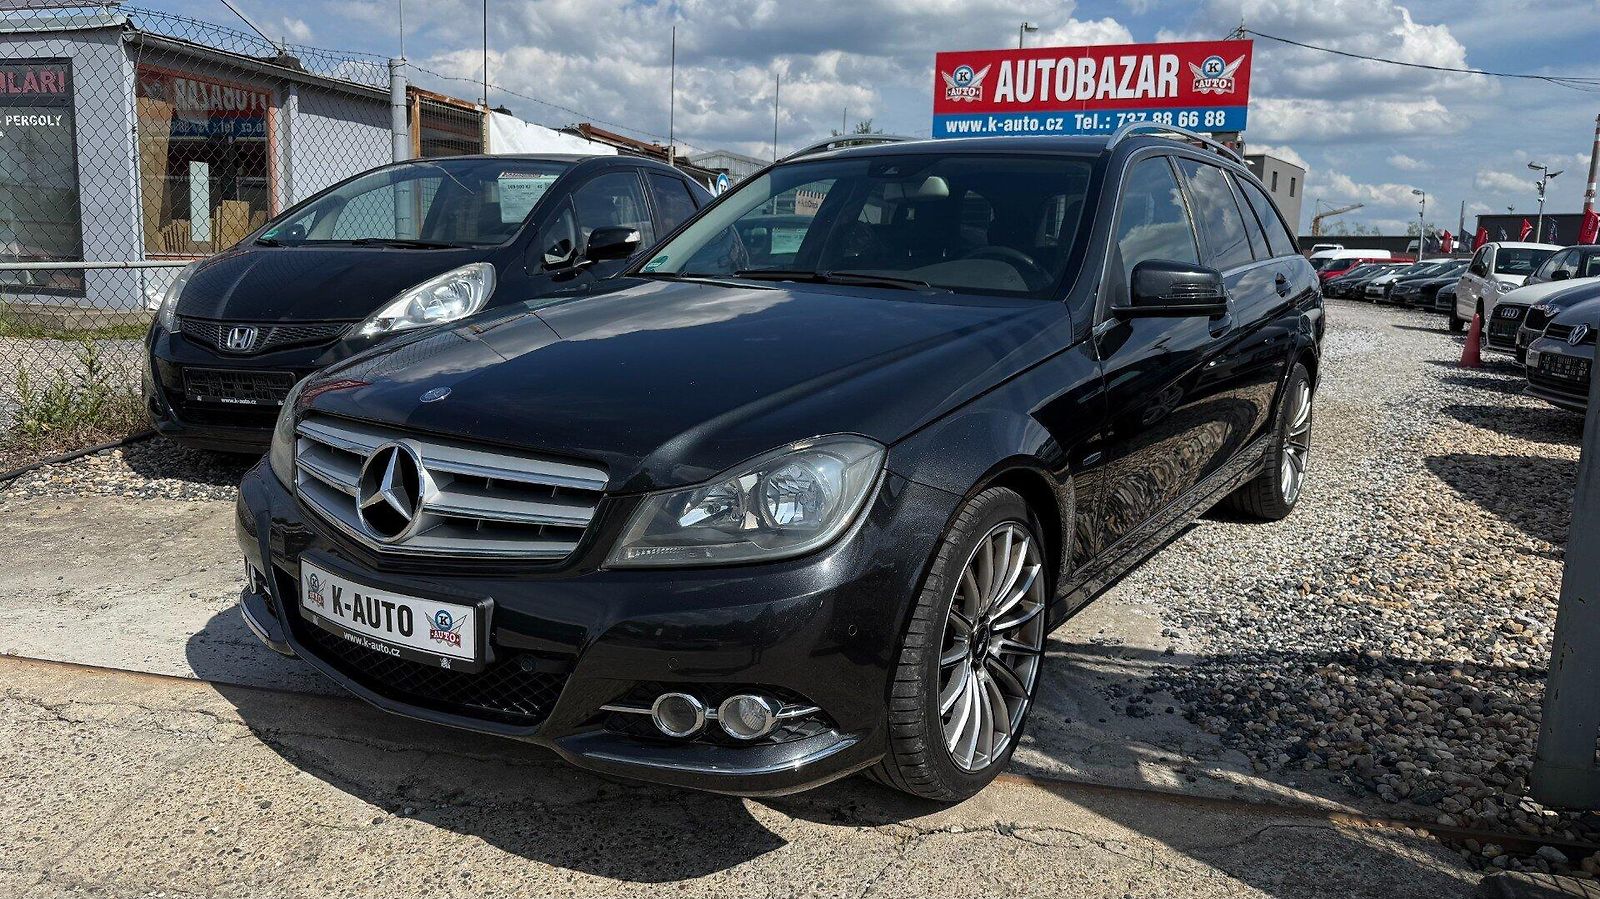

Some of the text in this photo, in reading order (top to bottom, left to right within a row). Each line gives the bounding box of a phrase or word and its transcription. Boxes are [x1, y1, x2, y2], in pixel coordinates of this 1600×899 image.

[1207, 62, 1219, 73] K
[958, 72, 969, 82] K
[993, 54, 1180, 103] AUTOBAZAR
[1198, 79, 1227, 89] AUTO
[951, 87, 976, 97] AUTO
[5, 114, 63, 127] PERGOLY
[945, 115, 1063, 133] www.k-auto.cz
[1074, 113, 1110, 130] Tel.:
[1152, 111, 1173, 125] 88
[1178, 110, 1199, 127] 66
[1204, 110, 1226, 127] 88
[331, 584, 414, 638] K-AUTO
[438, 615, 449, 627] K
[433, 630, 456, 643] AUTO
[343, 631, 401, 658] www.k-auto.cz
